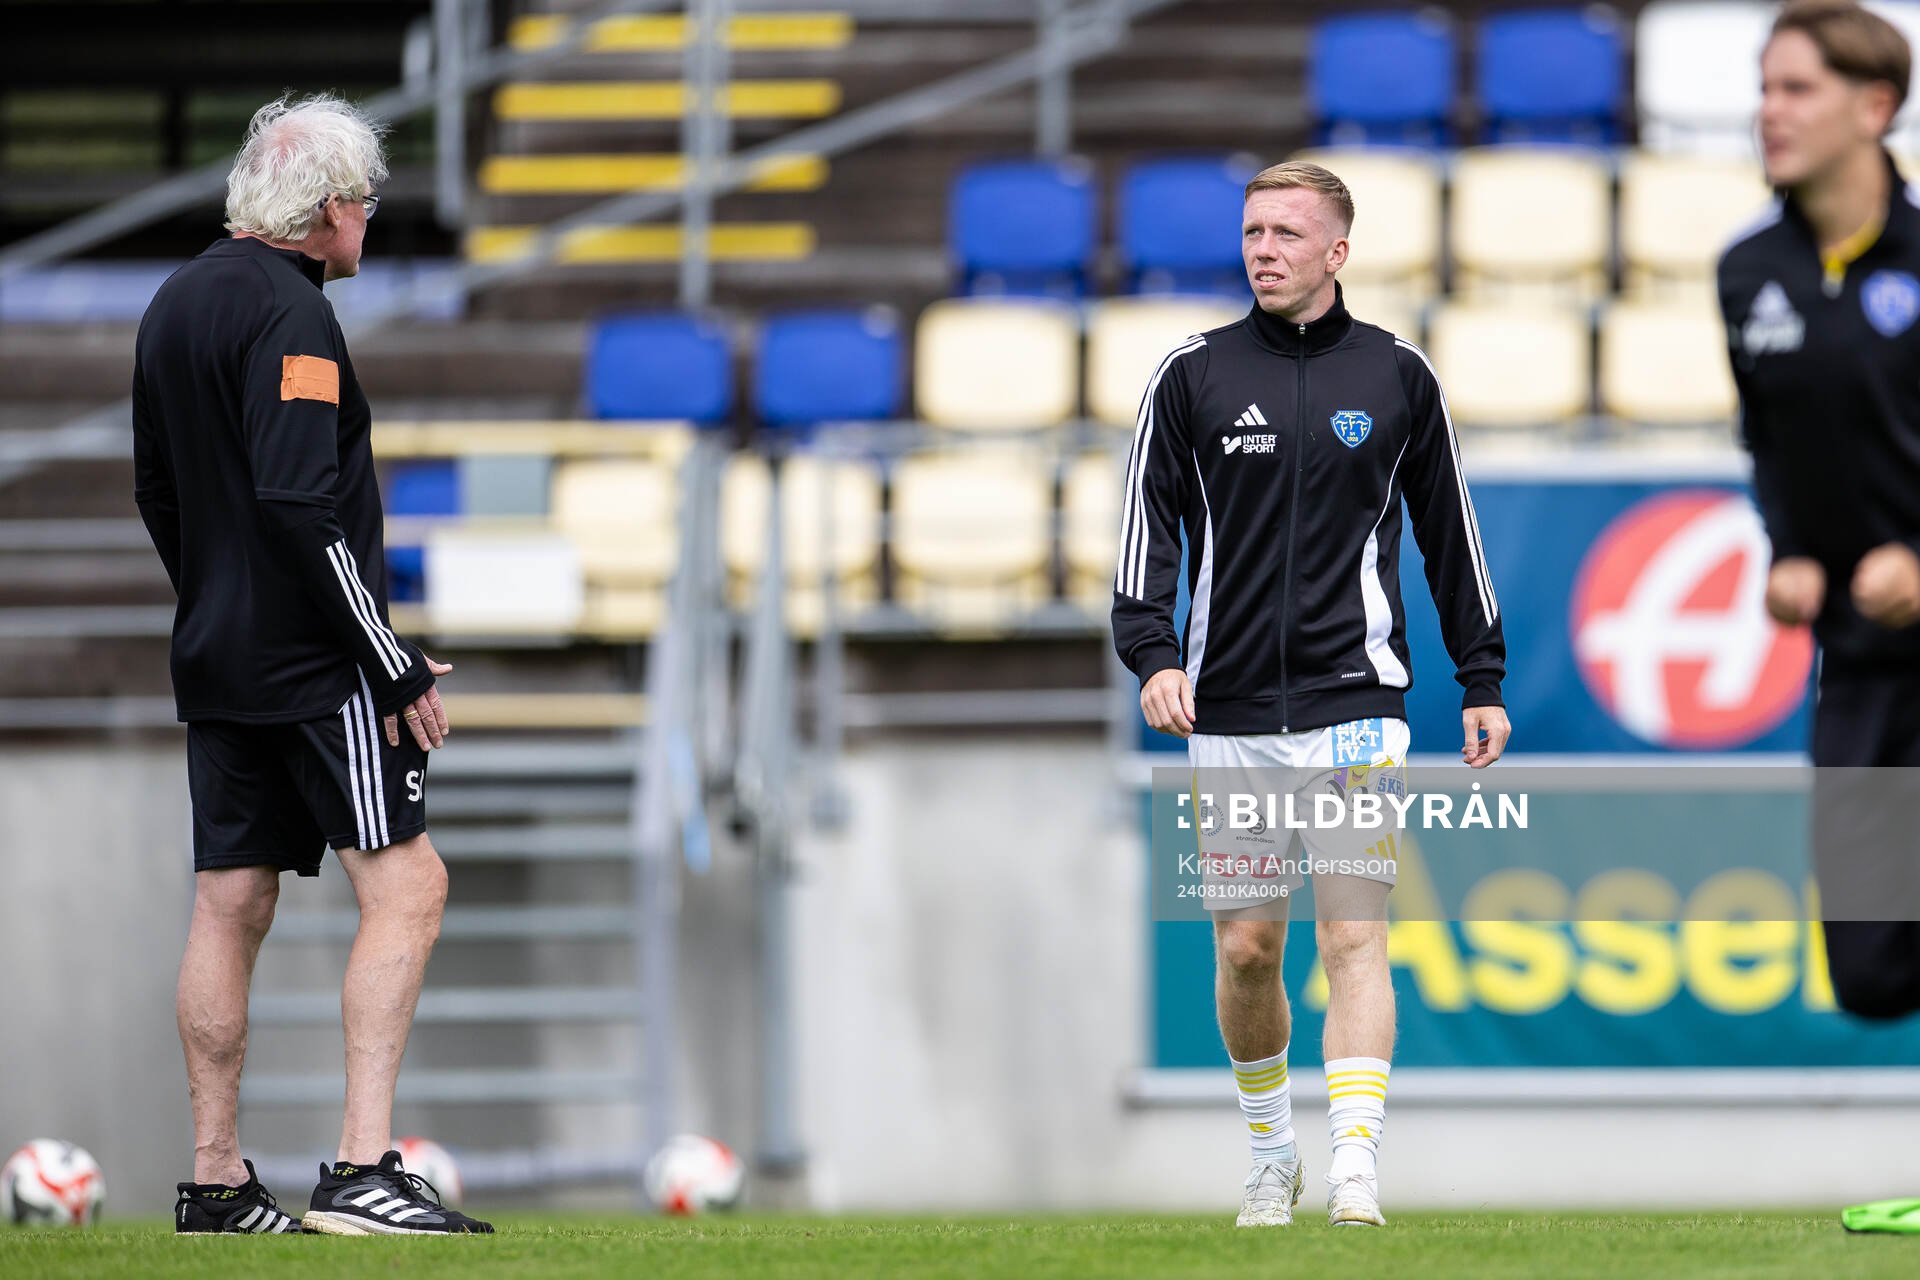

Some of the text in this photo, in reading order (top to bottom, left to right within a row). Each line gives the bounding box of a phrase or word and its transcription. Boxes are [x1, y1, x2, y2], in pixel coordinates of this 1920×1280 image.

[1243, 434, 1276, 444] INTER
[1242, 443, 1276, 453] SPORT
[1336, 730, 1379, 747] EKT
[406, 769, 425, 802] S
